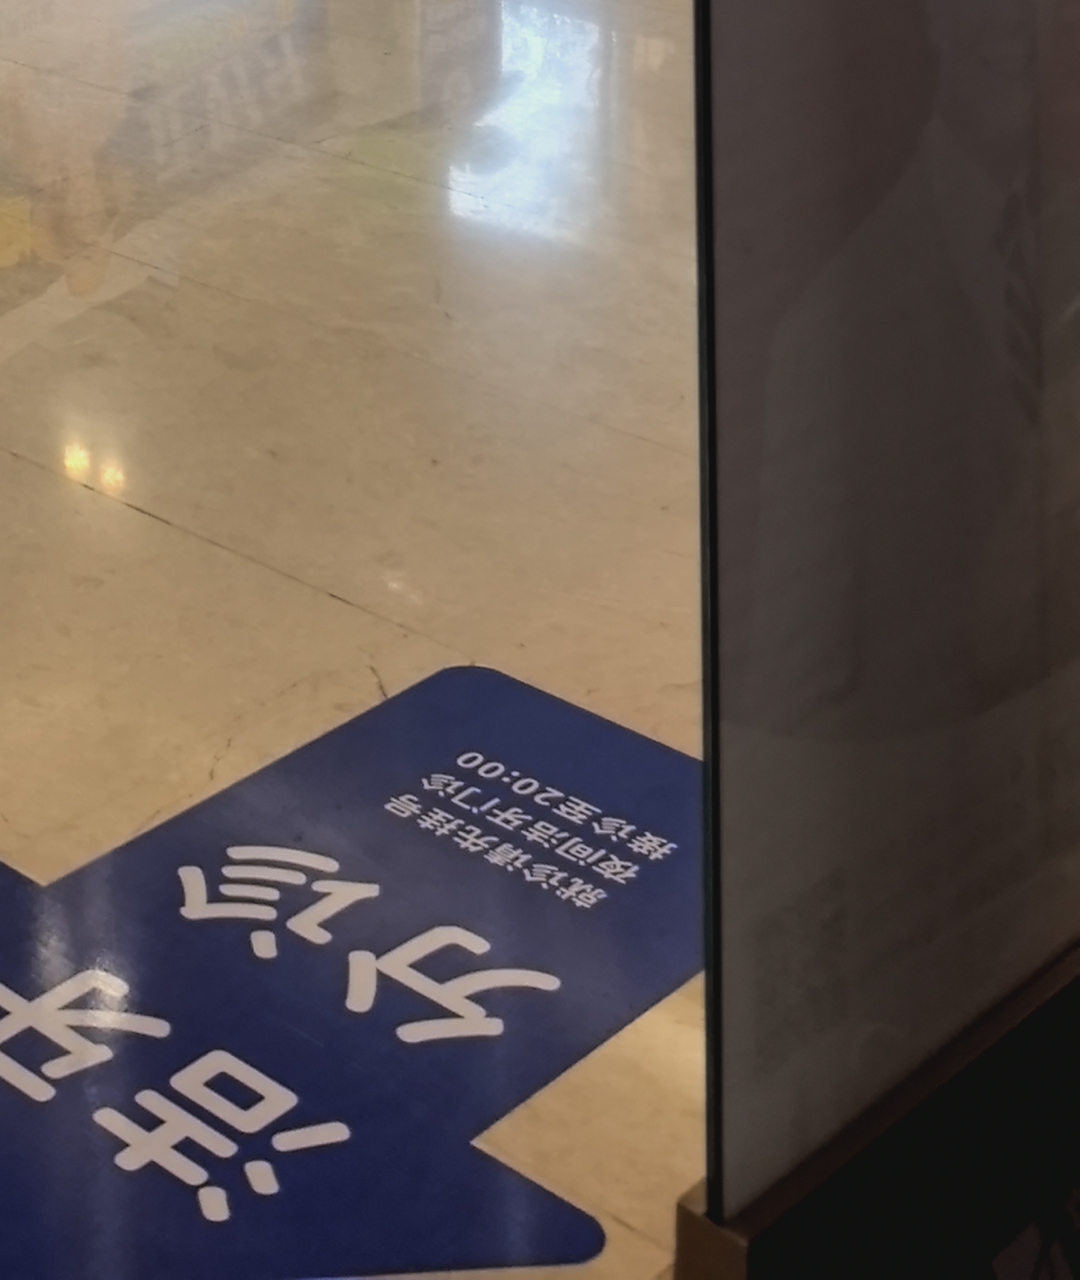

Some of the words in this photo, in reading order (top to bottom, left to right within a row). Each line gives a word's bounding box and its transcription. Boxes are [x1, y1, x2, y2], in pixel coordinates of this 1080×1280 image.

[383, 793, 608, 909] 就诊请先挂号
[421, 773, 641, 885] 夜间洁牙门诊
[456, 751, 678, 861] 接诊至20:00
[177, 845, 562, 1044] 分诊
